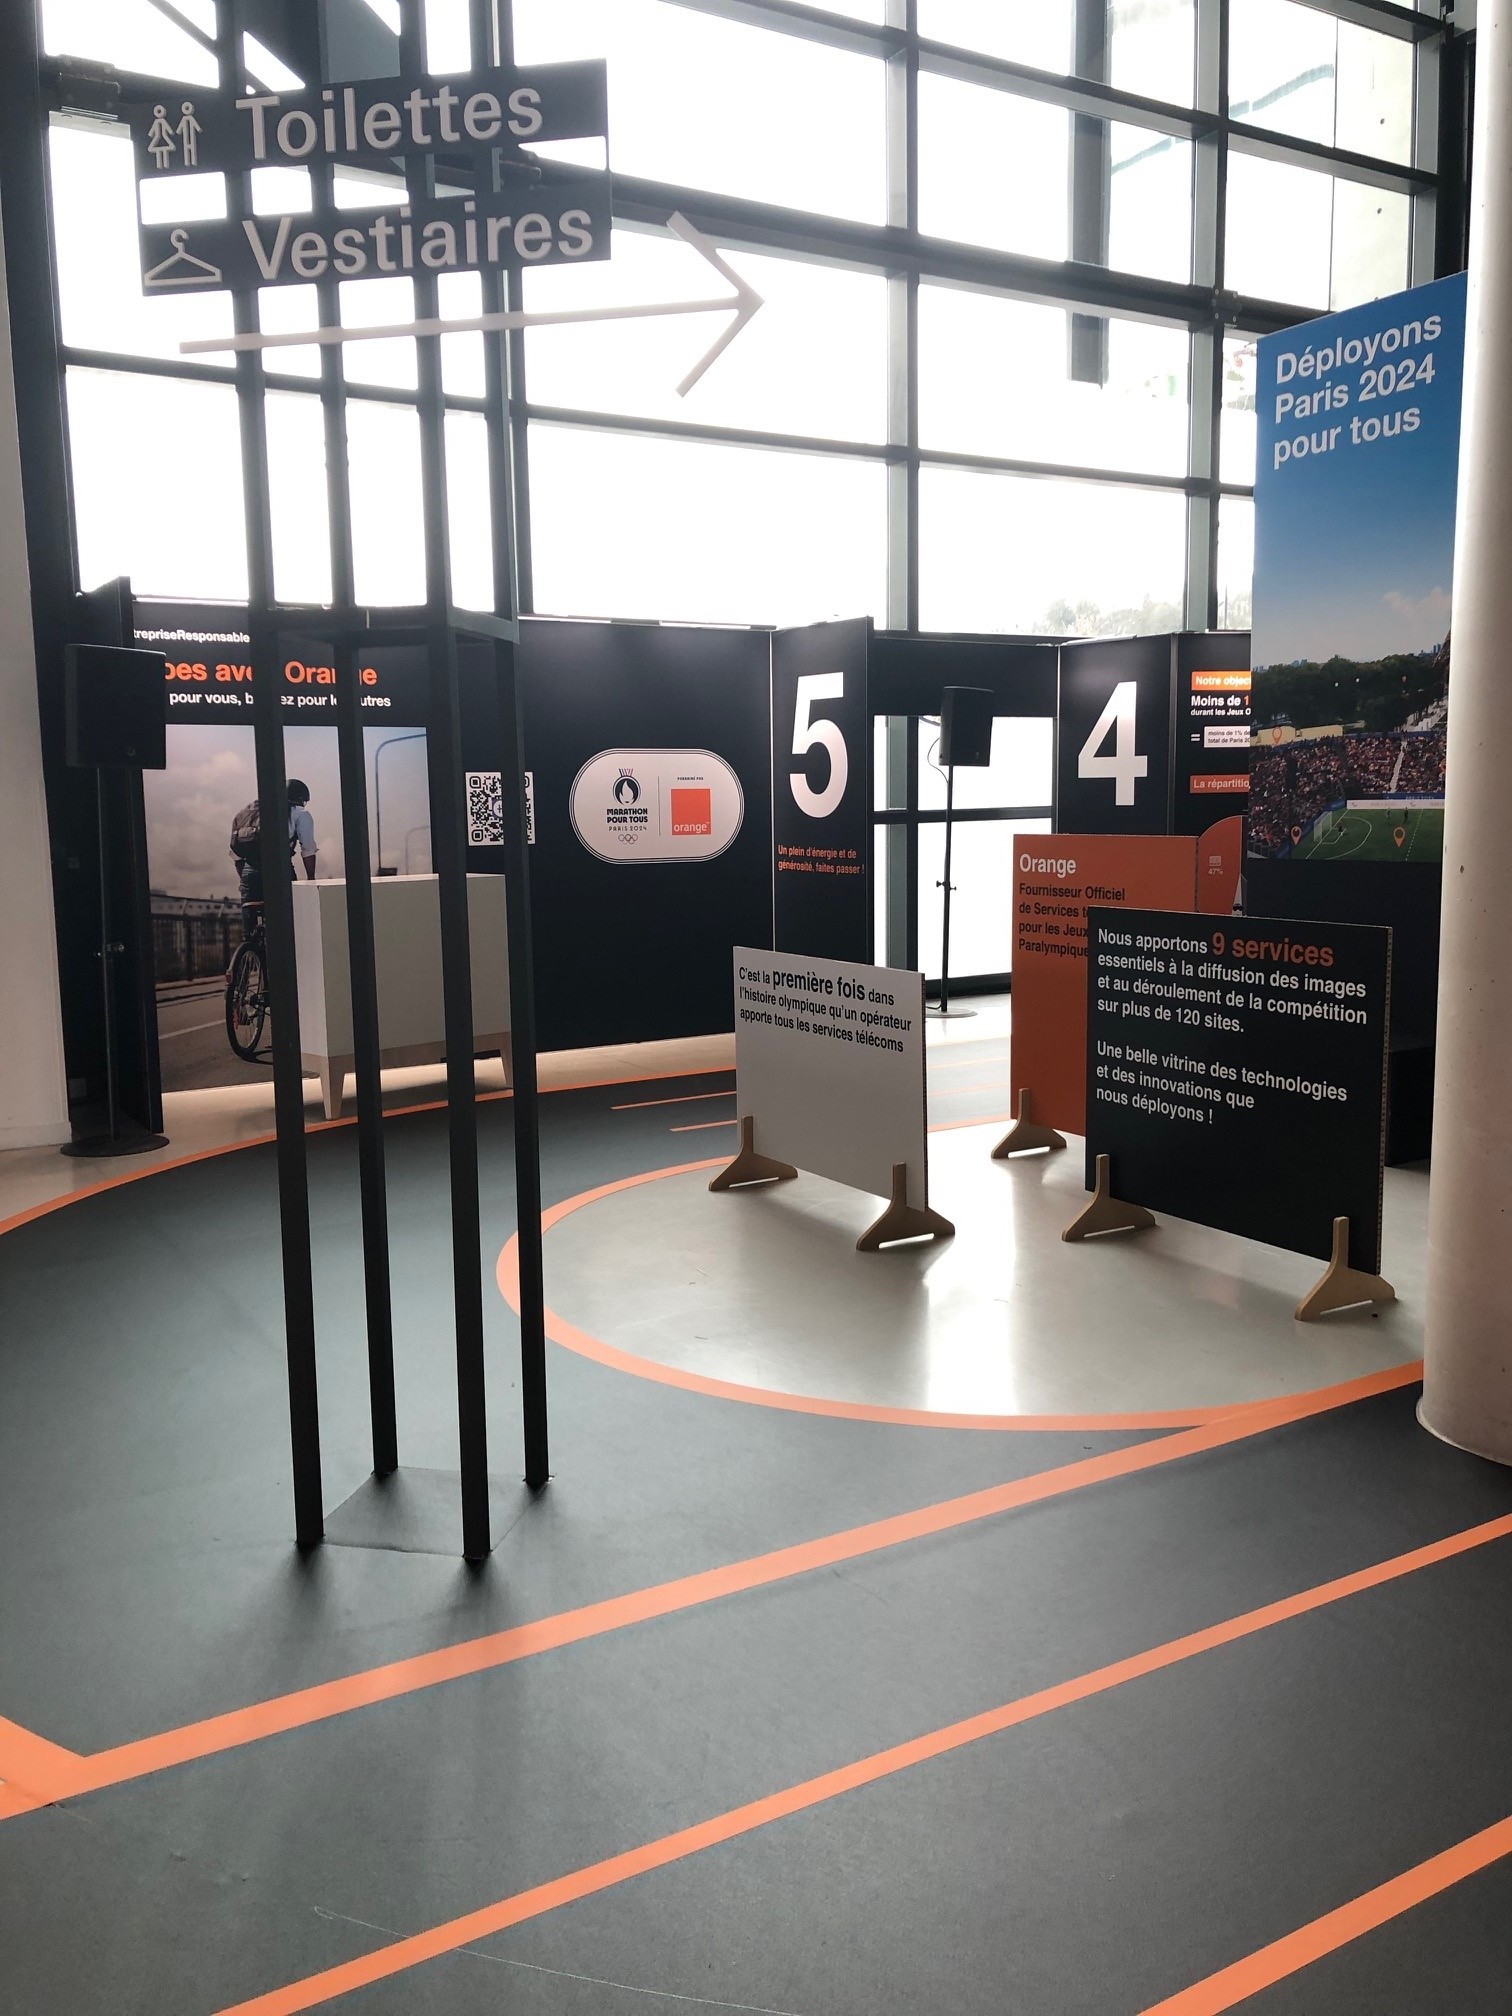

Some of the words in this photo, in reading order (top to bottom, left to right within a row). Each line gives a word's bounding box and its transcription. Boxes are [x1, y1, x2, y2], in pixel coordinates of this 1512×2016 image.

[236, 84, 543, 160] Toilettes
[242, 201, 593, 280] Vestiaires
[1276, 315, 1442, 385] Déployons
[1276, 381, 1349, 425] Paris
[1358, 352, 1436, 402] 2024
[1274, 425, 1342, 471] pour
[1350, 408, 1421, 444] tous
[134, 628, 250, 643] trepriseResponsable
[284, 660, 378, 686] Orae
[1196, 676, 1221, 686] Notre
[170, 692, 202, 705] pour
[205, 694, 242, 706] vous,
[298, 696, 328, 708] pour
[361, 695, 392, 707] utres
[1191, 695, 1225, 707] Moins
[1227, 695, 1241, 706] de
[1191, 708, 1214, 716] durant
[1215, 708, 1226, 716] les
[1227, 708, 1244, 716] Jeux
[1246, 708, 1251, 716] O
[790, 672, 848, 819] 5
[1078, 681, 1148, 805] 4
[1194, 780, 1205, 788] La
[1208, 779, 1250, 790] répartitio
[607, 808, 648, 816] MARATHON
[607, 816, 628, 824] POUR
[674, 824, 707, 833] orange
[778, 844, 787, 855] Un
[788, 846, 805, 858] plein
[806, 846, 838, 860] d'énergie
[839, 849, 846, 858] et
[848, 849, 857, 859] de
[778, 860, 815, 872] générosité,
[816, 862, 835, 873] faites
[836, 866, 860, 875] passer
[1020, 854, 1077, 879] Orange
[1020, 883, 1082, 898] Fournisseur
[1085, 886, 1125, 900] Officiel
[1019, 902, 1031, 914] de
[1034, 902, 1079, 917] Services
[1019, 922, 1042, 934] pour
[1045, 922, 1060, 935] les
[1063, 924, 1088, 938] Jeux
[1098, 928, 1132, 946] Nous
[1136, 935, 1208, 954] apportons
[1212, 932, 1225, 956] 9
[1232, 937, 1334, 967] services
[739, 966, 760, 983] C'est
[762, 971, 770, 984] la
[773, 970, 833, 995] première
[837, 976, 865, 1000] fois
[868, 989, 894, 1005] dans
[1098, 954, 1165, 973] essentiels
[1169, 958, 1177, 975] à
[1181, 960, 1194, 977] la
[1198, 962, 1265, 986] diffusion
[1270, 970, 1299, 989] des
[1304, 974, 1366, 999] images
[740, 986, 776, 1006] l'histoire
[779, 994, 826, 1016] olympique
[829, 1007, 857, 1022] qu'un
[860, 1010, 912, 1031] opérateur
[1098, 975, 1110, 989] et
[1113, 978, 1129, 992] au
[1133, 978, 1221, 1005] déroulement
[1226, 990, 1244, 1007] de
[1249, 993, 1262, 1010] la
[1267, 998, 1367, 1025] compétition
[1098, 999, 1118, 1013] sur
[1122, 1001, 1151, 1018] plus
[1154, 1005, 1171, 1021] de
[1176, 1008, 1200, 1025] 120
[1204, 1013, 1244, 1032] sites.
[740, 1008, 772, 1025] apporte
[774, 1014, 794, 1030] tous
[796, 1017, 810, 1032] les
[813, 1023, 853, 1042] services
[856, 1029, 904, 1052] télécoms
[1096, 1065, 1108, 1079] et
[1112, 1066, 1136, 1084] des
[1140, 1071, 1221, 1102] innovations
[1226, 1092, 1255, 1109] que
[1098, 1040, 1122, 1059] Une
[1126, 1046, 1158, 1066] belle
[1162, 1054, 1206, 1075] vitrine
[1210, 1062, 1237, 1081] des
[1242, 1067, 1347, 1101] technologies
[1096, 1088, 1128, 1105] nous
[1132, 1093, 1204, 1122] déployons
[1209, 1108, 1213, 1124] !
